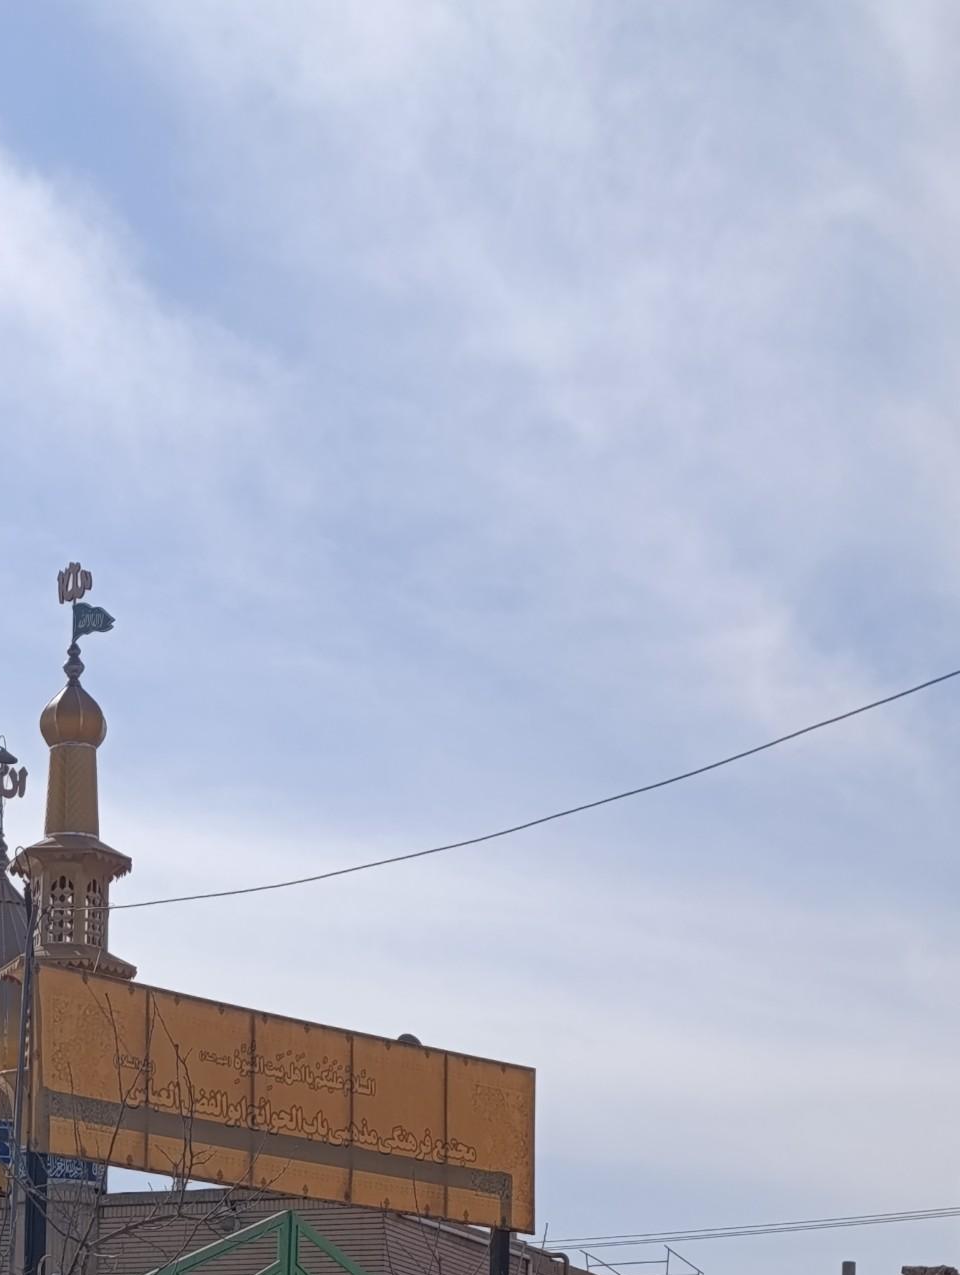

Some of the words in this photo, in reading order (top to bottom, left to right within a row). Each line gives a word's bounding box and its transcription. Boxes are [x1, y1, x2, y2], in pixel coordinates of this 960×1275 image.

[126, 1078, 182, 1112] العباس
[302, 1110, 329, 1143] باب
[328, 1118, 379, 1148] مذهبی
[377, 1125, 433, 1162] فرهنگی
[433, 1138, 477, 1167] مجتمع
